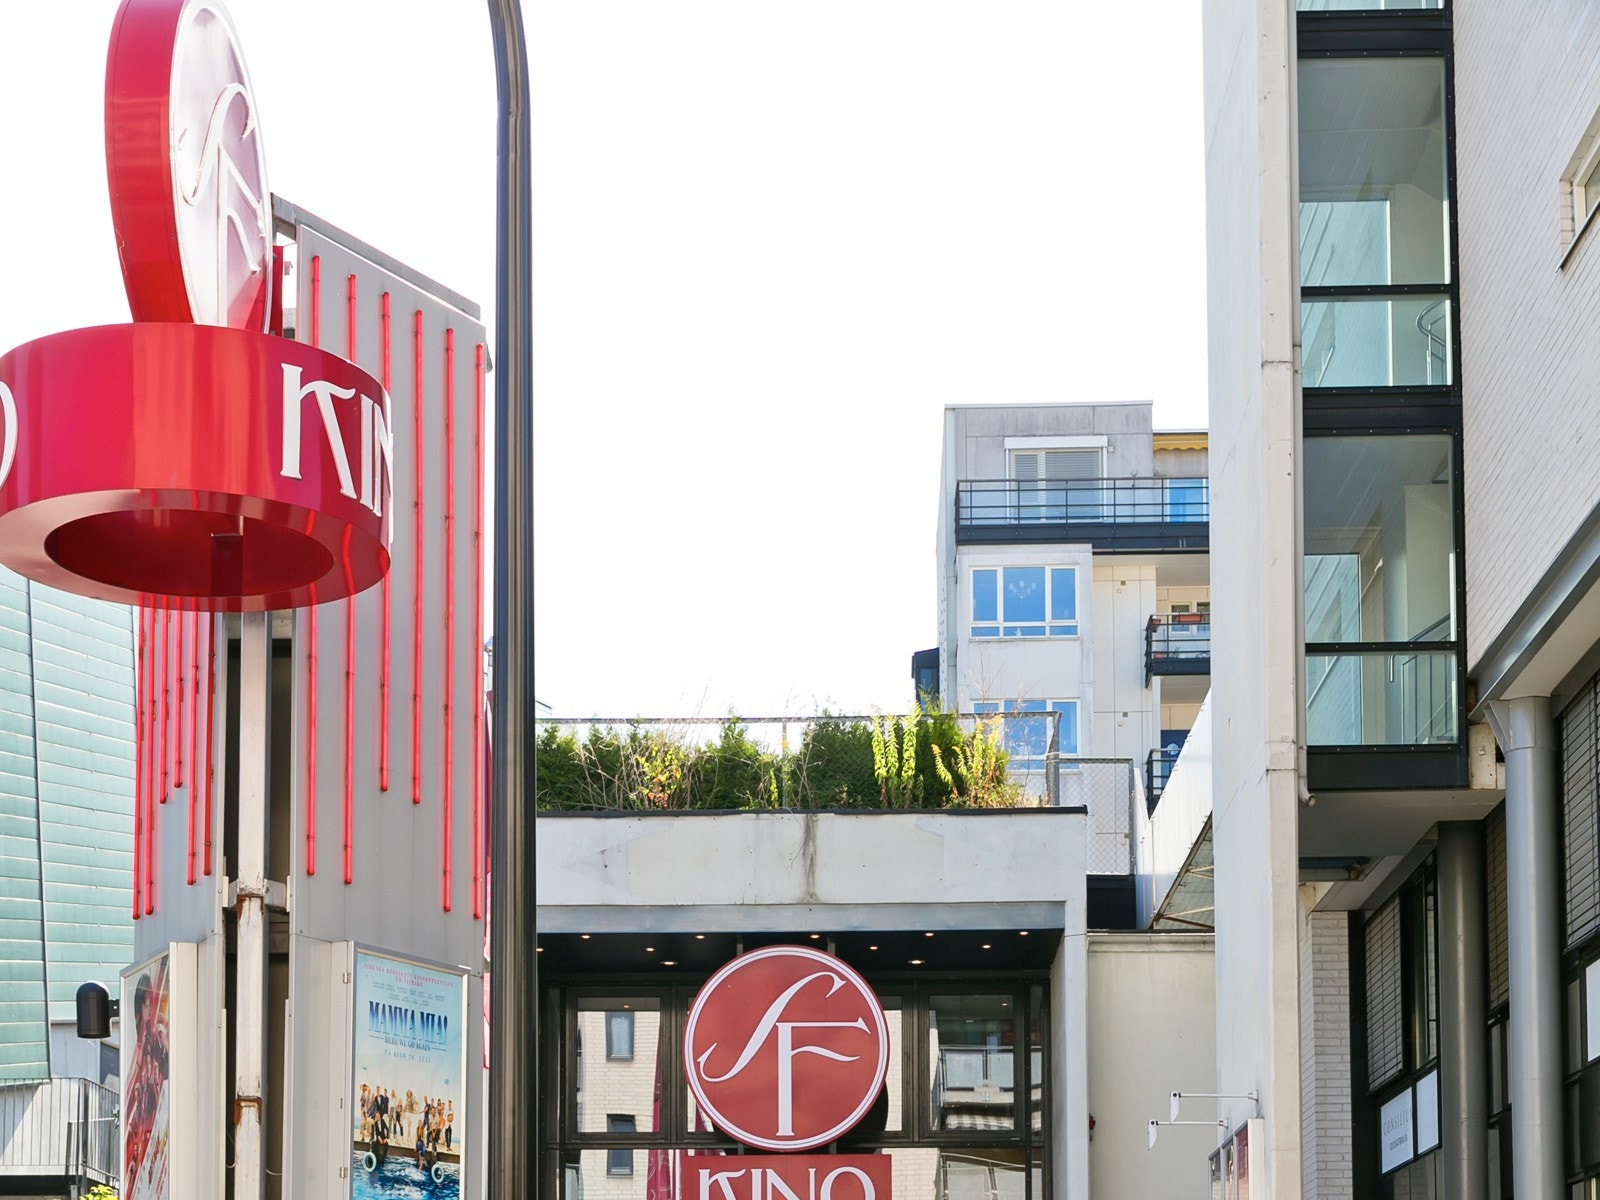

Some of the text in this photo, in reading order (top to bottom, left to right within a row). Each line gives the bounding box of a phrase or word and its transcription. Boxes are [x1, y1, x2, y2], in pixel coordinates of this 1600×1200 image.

[280, 362, 393, 518] KIN
[368, 1000, 448, 1046] MAMMA MIA!
[697, 971, 871, 1137] SF
